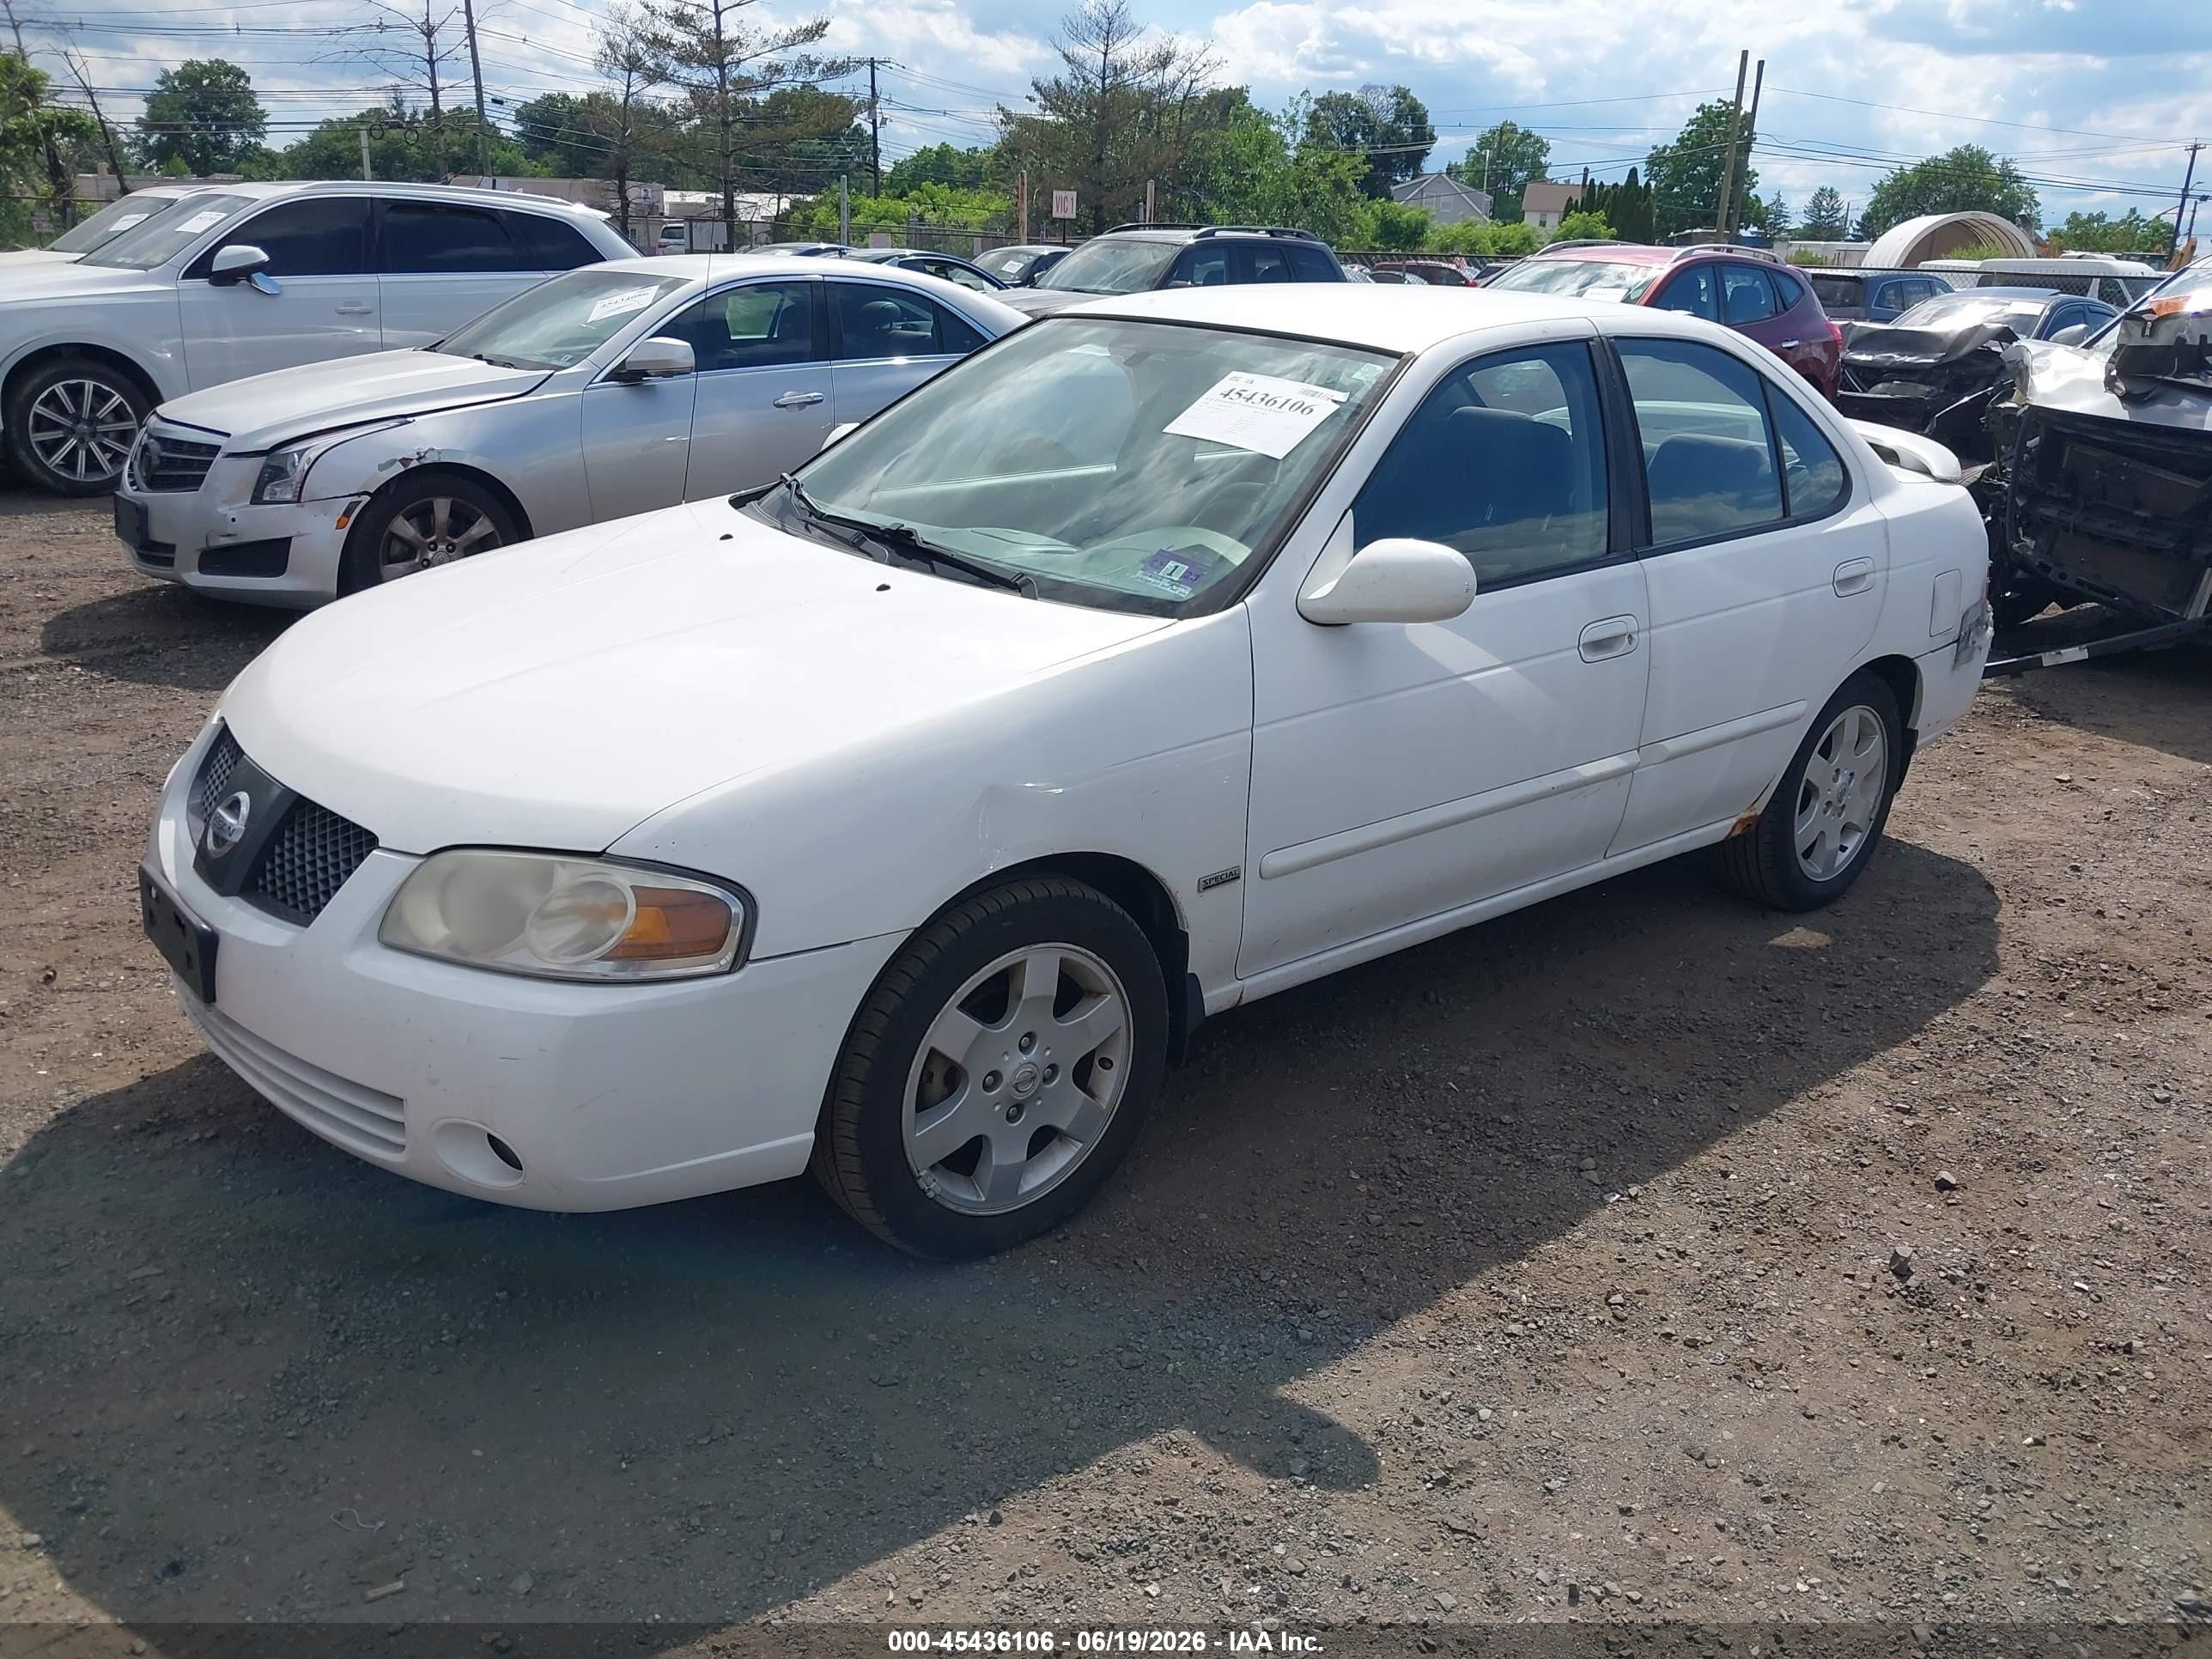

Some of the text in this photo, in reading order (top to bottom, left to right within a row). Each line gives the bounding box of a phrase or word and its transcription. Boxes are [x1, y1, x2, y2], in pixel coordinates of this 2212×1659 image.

[1056, 195, 1068, 214] VIC
[1219, 387, 1318, 416] 45436106
[1167, 565, 1179, 576] 1
[1202, 870, 1240, 885] SPECIAL
